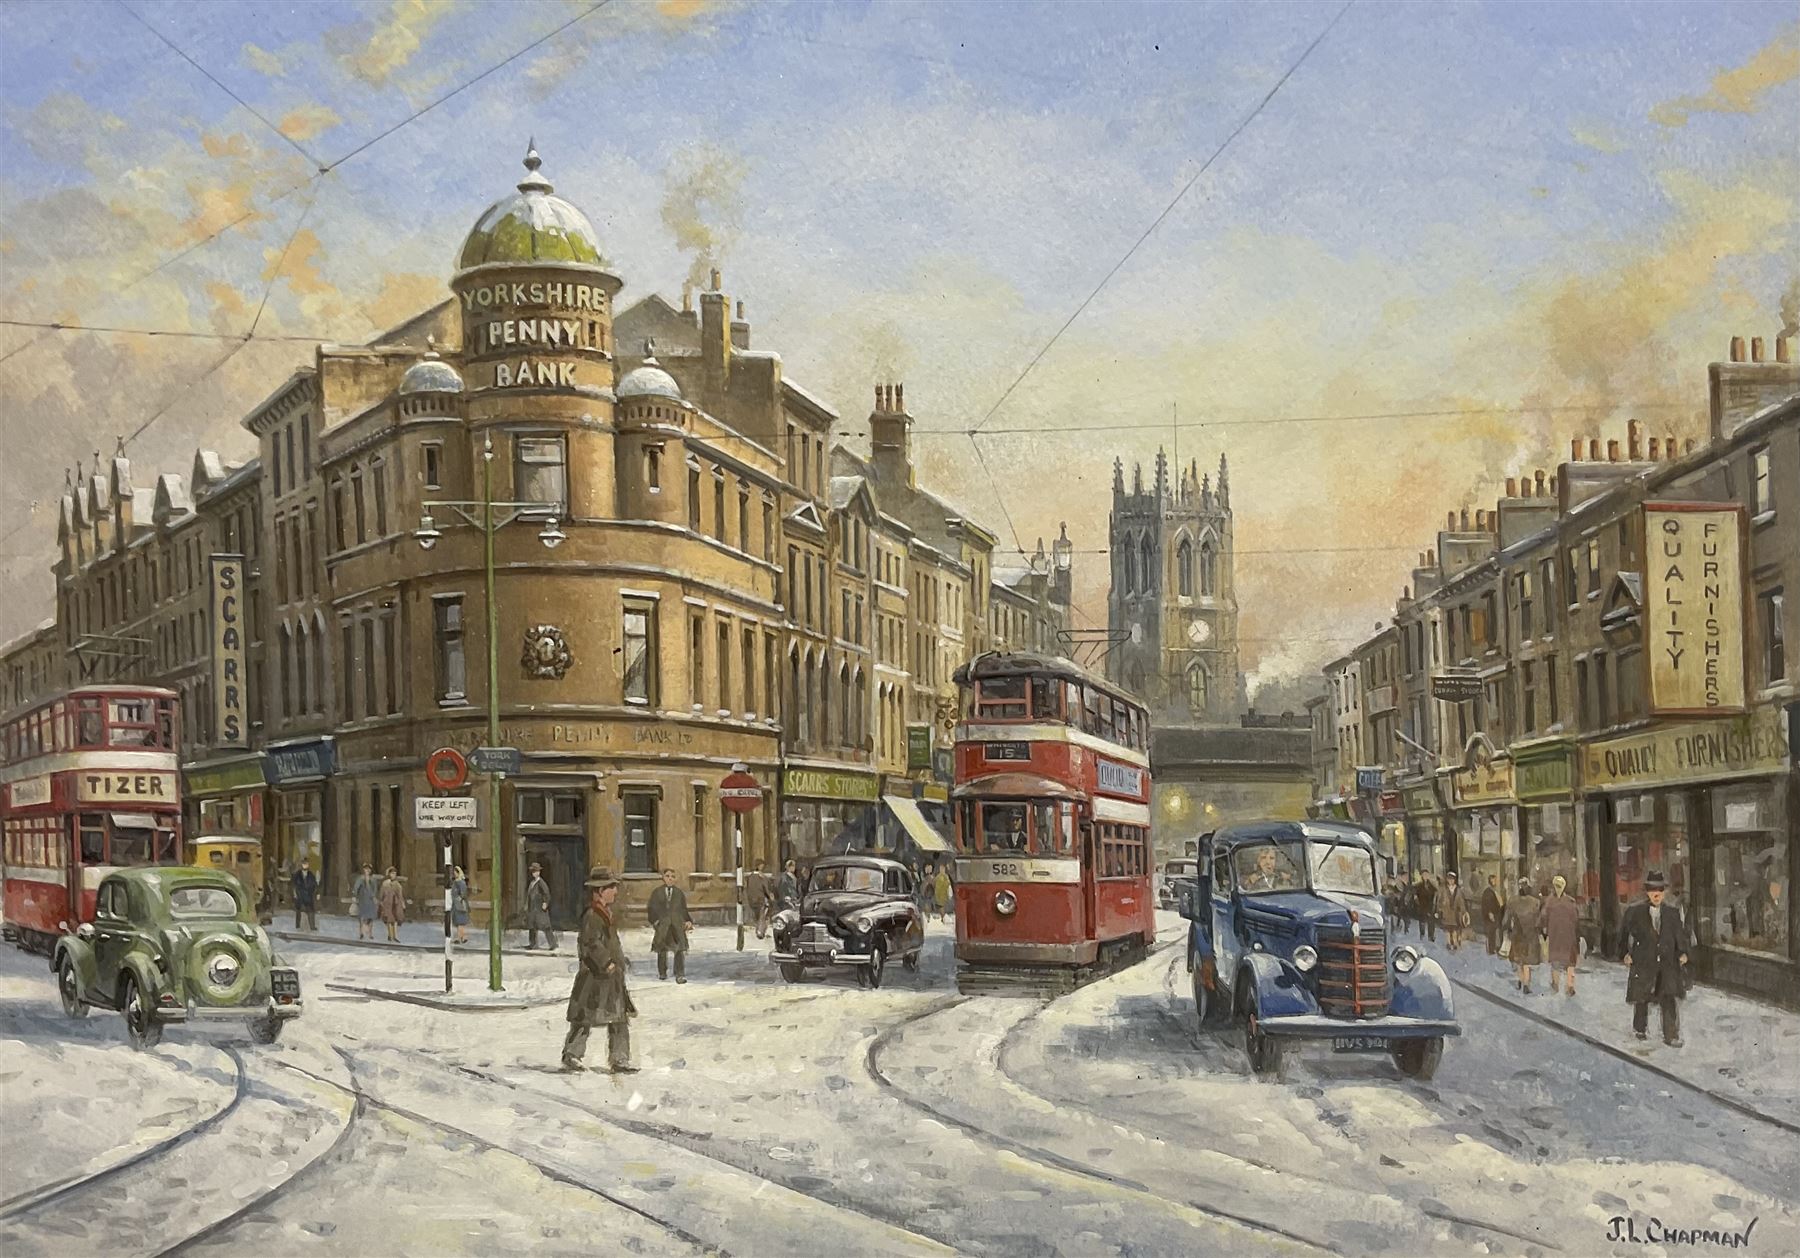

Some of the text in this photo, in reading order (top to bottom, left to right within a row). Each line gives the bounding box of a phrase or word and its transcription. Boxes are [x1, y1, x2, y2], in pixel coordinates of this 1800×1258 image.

[462, 282, 606, 310] YORKSHIRE
[490, 320, 580, 345] PENNY
[497, 361, 575, 386] BANK
[1662, 519, 1684, 670] QUALITY
[1703, 523, 1719, 707] FURNISHERS
[220, 566, 239, 740] SCARRS
[484, 751, 511, 760] YORK
[999, 749, 1015, 758] 15
[86, 776, 164, 796] TIZER
[789, 770, 829, 793] SCARRS
[422, 800, 469, 809] KEEP LEFT
[992, 864, 1019, 875] 582
